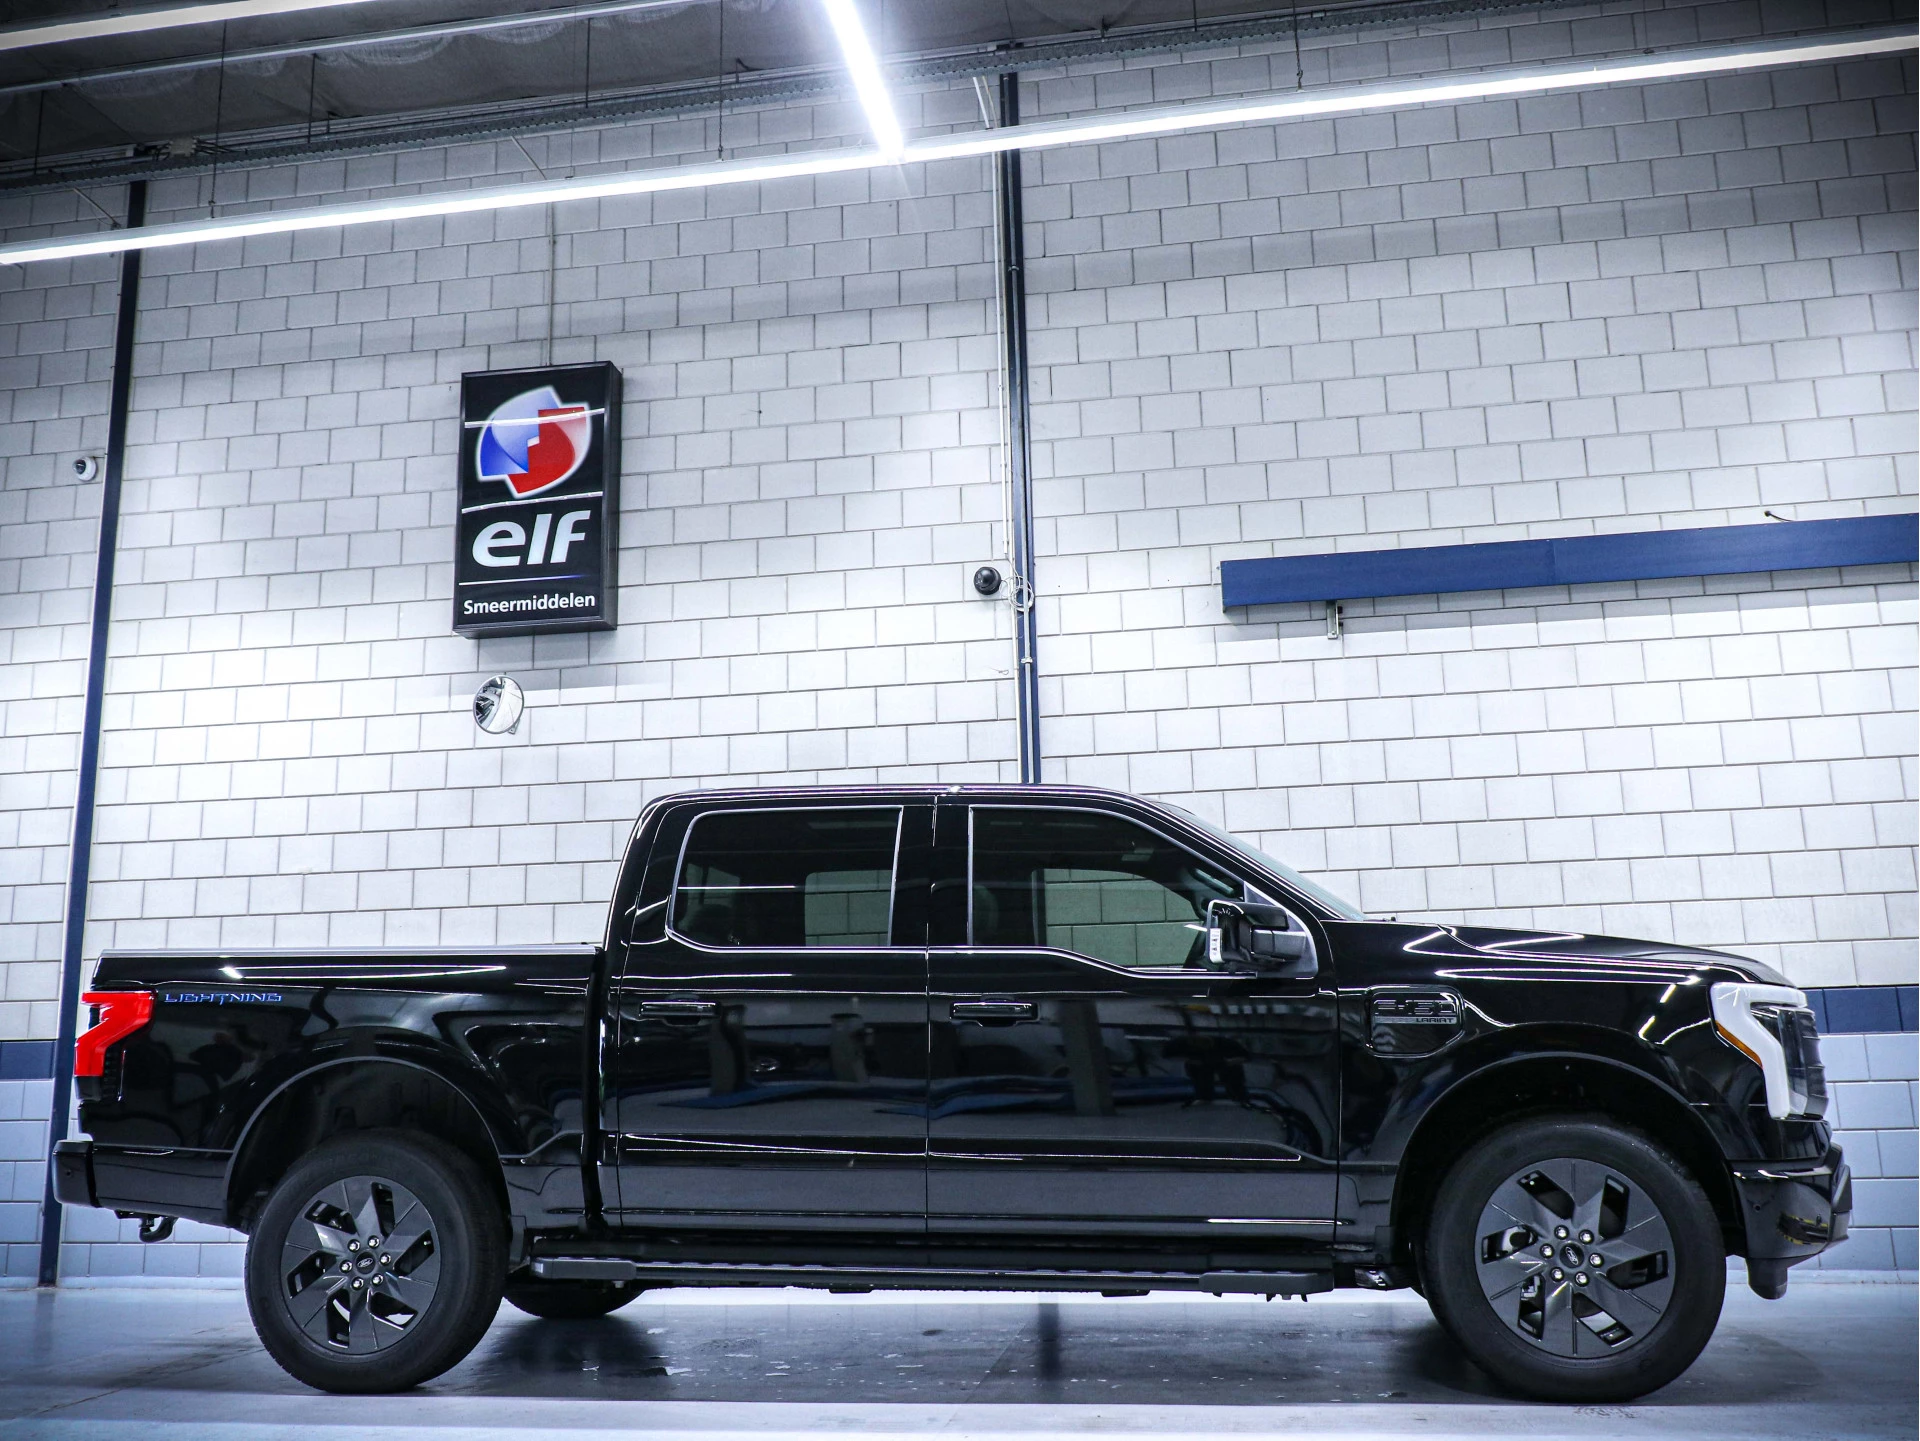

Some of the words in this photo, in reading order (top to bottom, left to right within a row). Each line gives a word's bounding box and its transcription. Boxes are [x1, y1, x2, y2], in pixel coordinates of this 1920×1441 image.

[472, 510, 591, 567] elf
[463, 592, 595, 615] Smeermiddelen
[164, 992, 282, 1006] LIGHTNING
